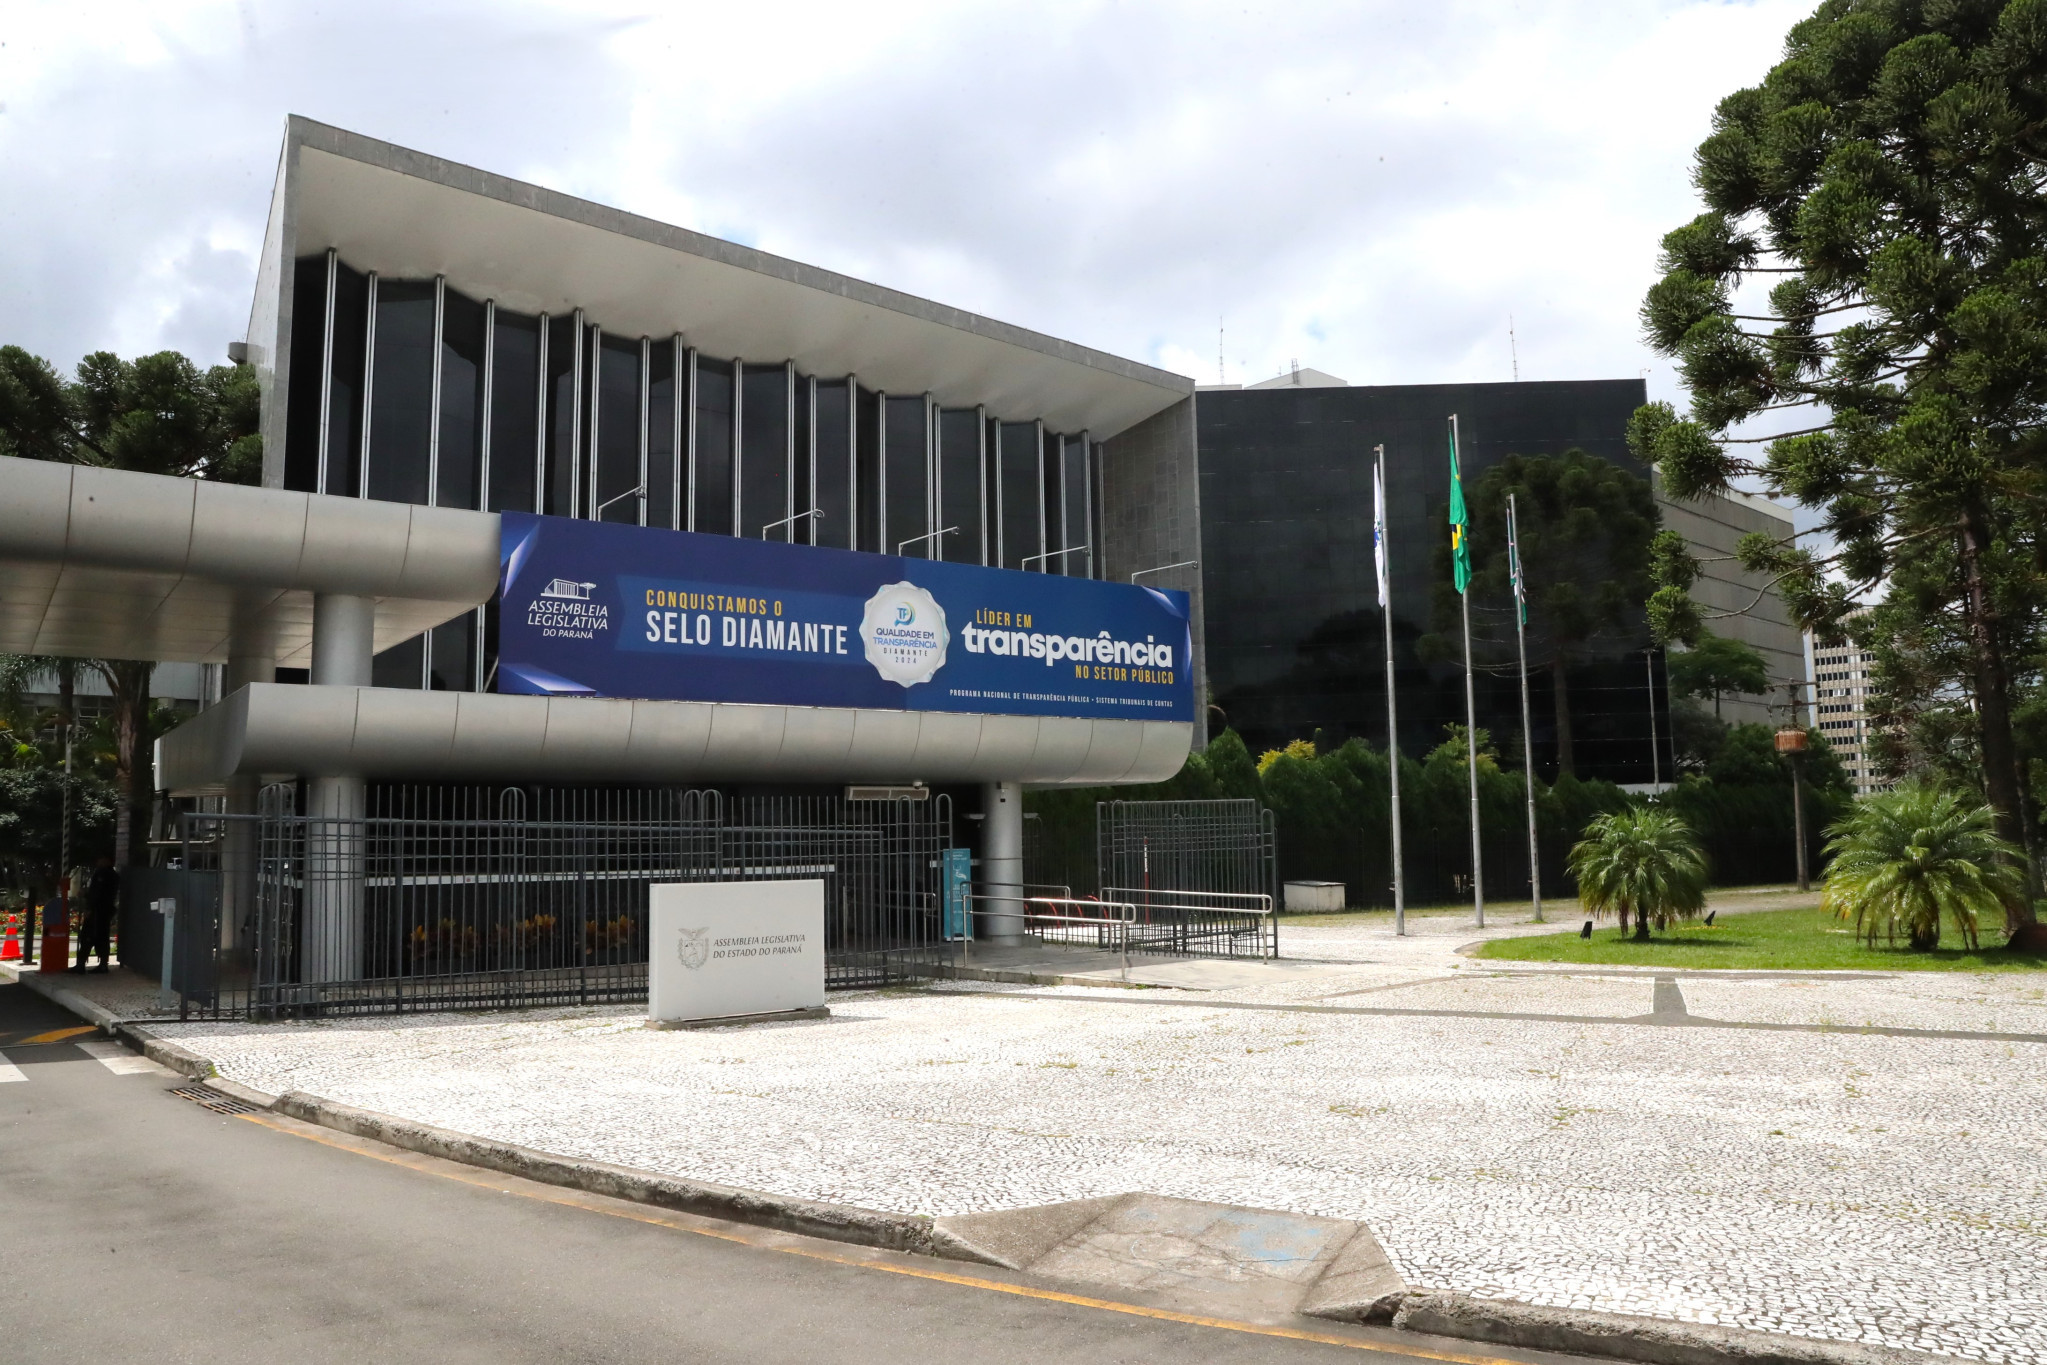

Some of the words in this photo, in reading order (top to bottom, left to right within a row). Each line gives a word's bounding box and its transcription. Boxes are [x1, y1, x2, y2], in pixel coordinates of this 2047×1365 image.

[528, 600, 608, 617] ASSEMBLEIA
[646, 589, 767, 615] CONQUISTAMOS
[774, 600, 782, 616] O
[527, 613, 608, 630] LEGISLATIVA
[976, 608, 1011, 627] LÍDER
[1016, 613, 1032, 628] EM
[543, 628, 556, 637] DO
[558, 629, 593, 639] PARANÁ
[646, 610, 711, 646] SELO
[722, 616, 848, 655] DIAMANTE
[876, 627, 921, 639] QUALIDADE
[923, 631, 934, 639] EM
[873, 636, 938, 649] TRANSPARÊNCIA
[961, 621, 1173, 668] transparência
[883, 647, 928, 657] DIAMANTE
[895, 656, 917, 664] 2024
[1075, 664, 1089, 679] NO
[1094, 666, 1127, 682] SETOR
[1131, 666, 1174, 685] PÚBLICO
[949, 688, 981, 698] PROGRAMA
[983, 690, 1011, 699] NACIONAL
[1013, 692, 1020, 700] DE
[1022, 693, 1066, 702] TRANSPARÊNCIA
[1067, 694, 1090, 703] PÚBLICA
[1095, 696, 1118, 705] SISTEMA
[1147, 699, 1153, 707] DE
[1155, 700, 1173, 708] CONTAS
[713, 936, 760, 947] ASSEMBLEIA
[761, 934, 806, 944] LEGISLATIVA
[713, 950, 726, 959] DO
[727, 948, 757, 958] ESTADO
[758, 947, 771, 956] DO
[772, 944, 802, 955] PARANÁ
